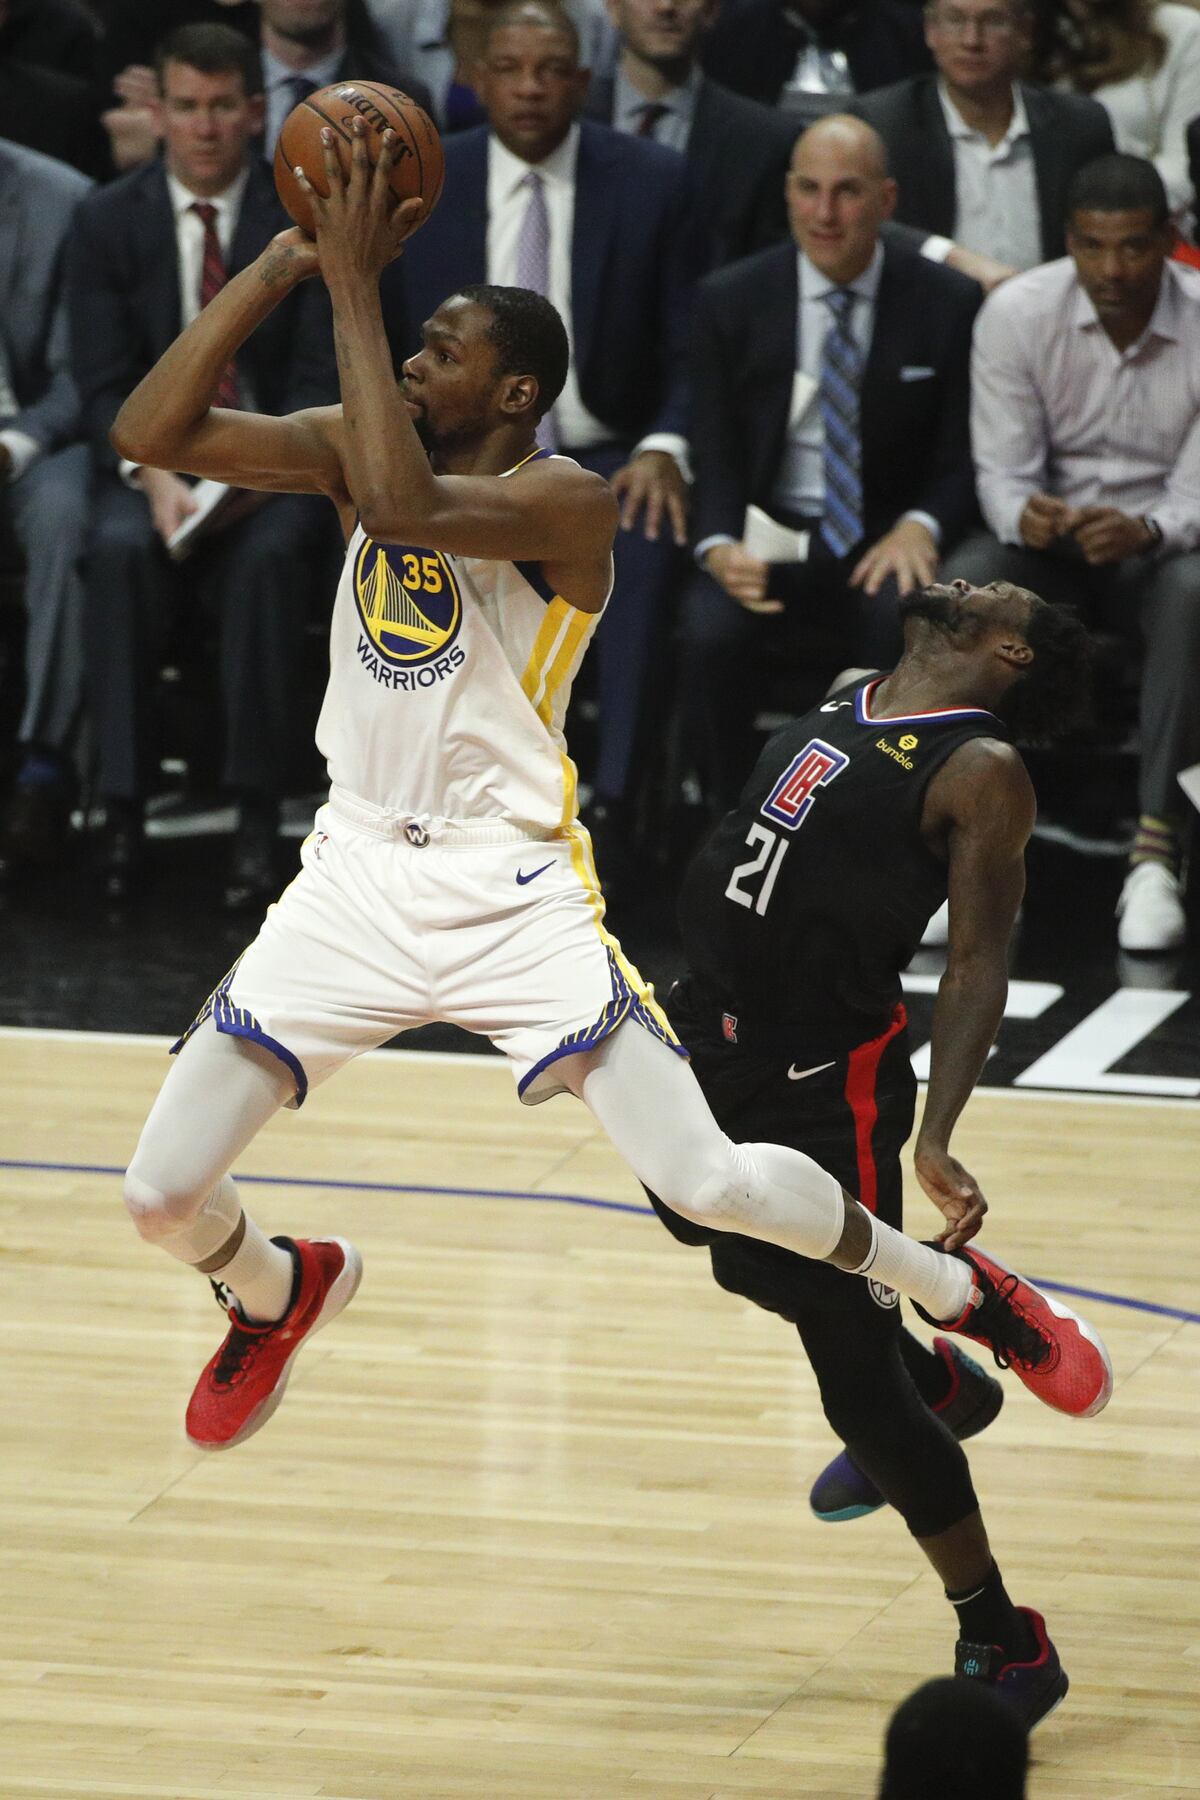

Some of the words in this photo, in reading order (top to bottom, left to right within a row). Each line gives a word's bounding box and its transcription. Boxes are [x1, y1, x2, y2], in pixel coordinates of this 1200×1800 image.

[401, 553, 444, 594] 35
[356, 633, 466, 691] WARRIORS
[875, 738, 914, 770] bumble
[725, 822, 790, 916] 21
